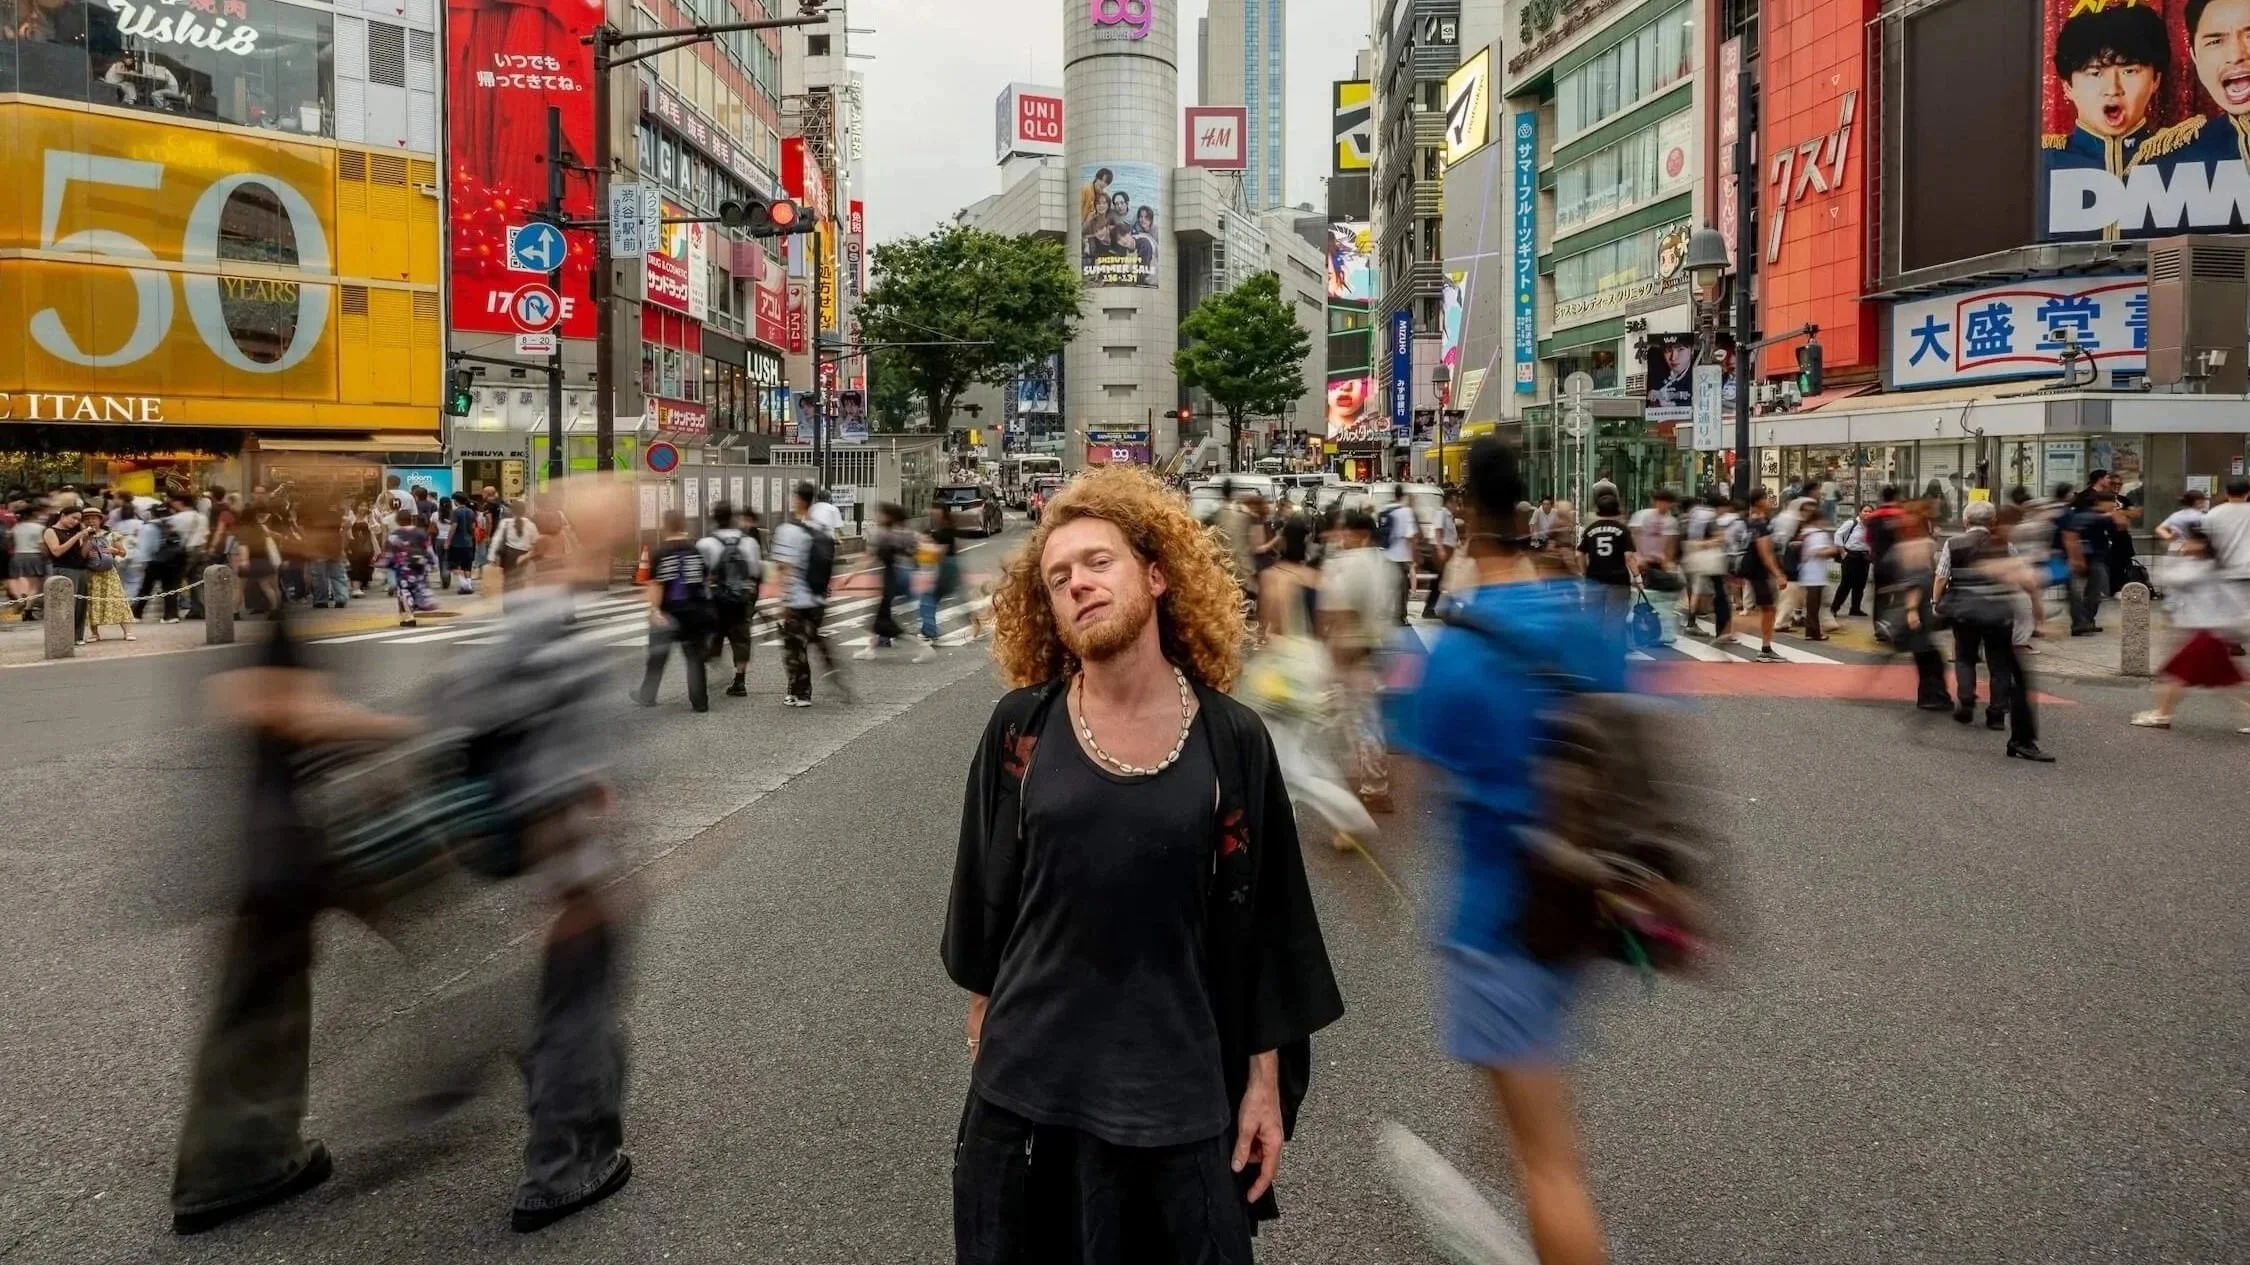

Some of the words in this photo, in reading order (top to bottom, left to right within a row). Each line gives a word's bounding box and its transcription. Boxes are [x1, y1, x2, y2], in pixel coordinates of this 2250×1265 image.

[494, 53, 560, 71] いつでも
[476, 71, 583, 92] 帰ってきてね。
[1024, 101, 1055, 119] UNI
[1024, 119, 1058, 138] QLO
[1201, 127, 1231, 148] H&M
[621, 189, 636, 252] 渋谷駅前
[1517, 143, 1532, 290] サマーフルーツギフト
[30, 148, 331, 374] 50
[1083, 264, 1129, 276] SUMMER
[1131, 264, 1157, 274] SALE
[223, 276, 298, 304] YEARS
[647, 269, 688, 301] サンドラッグ
[761, 291, 781, 321] アコム
[790, 312, 801, 340] アコム
[1399, 320, 1407, 355] MIZUHO
[747, 350, 779, 387] LUSH
[1111, 449, 1129, 462] 109
[1597, 536, 1613, 557] 5
